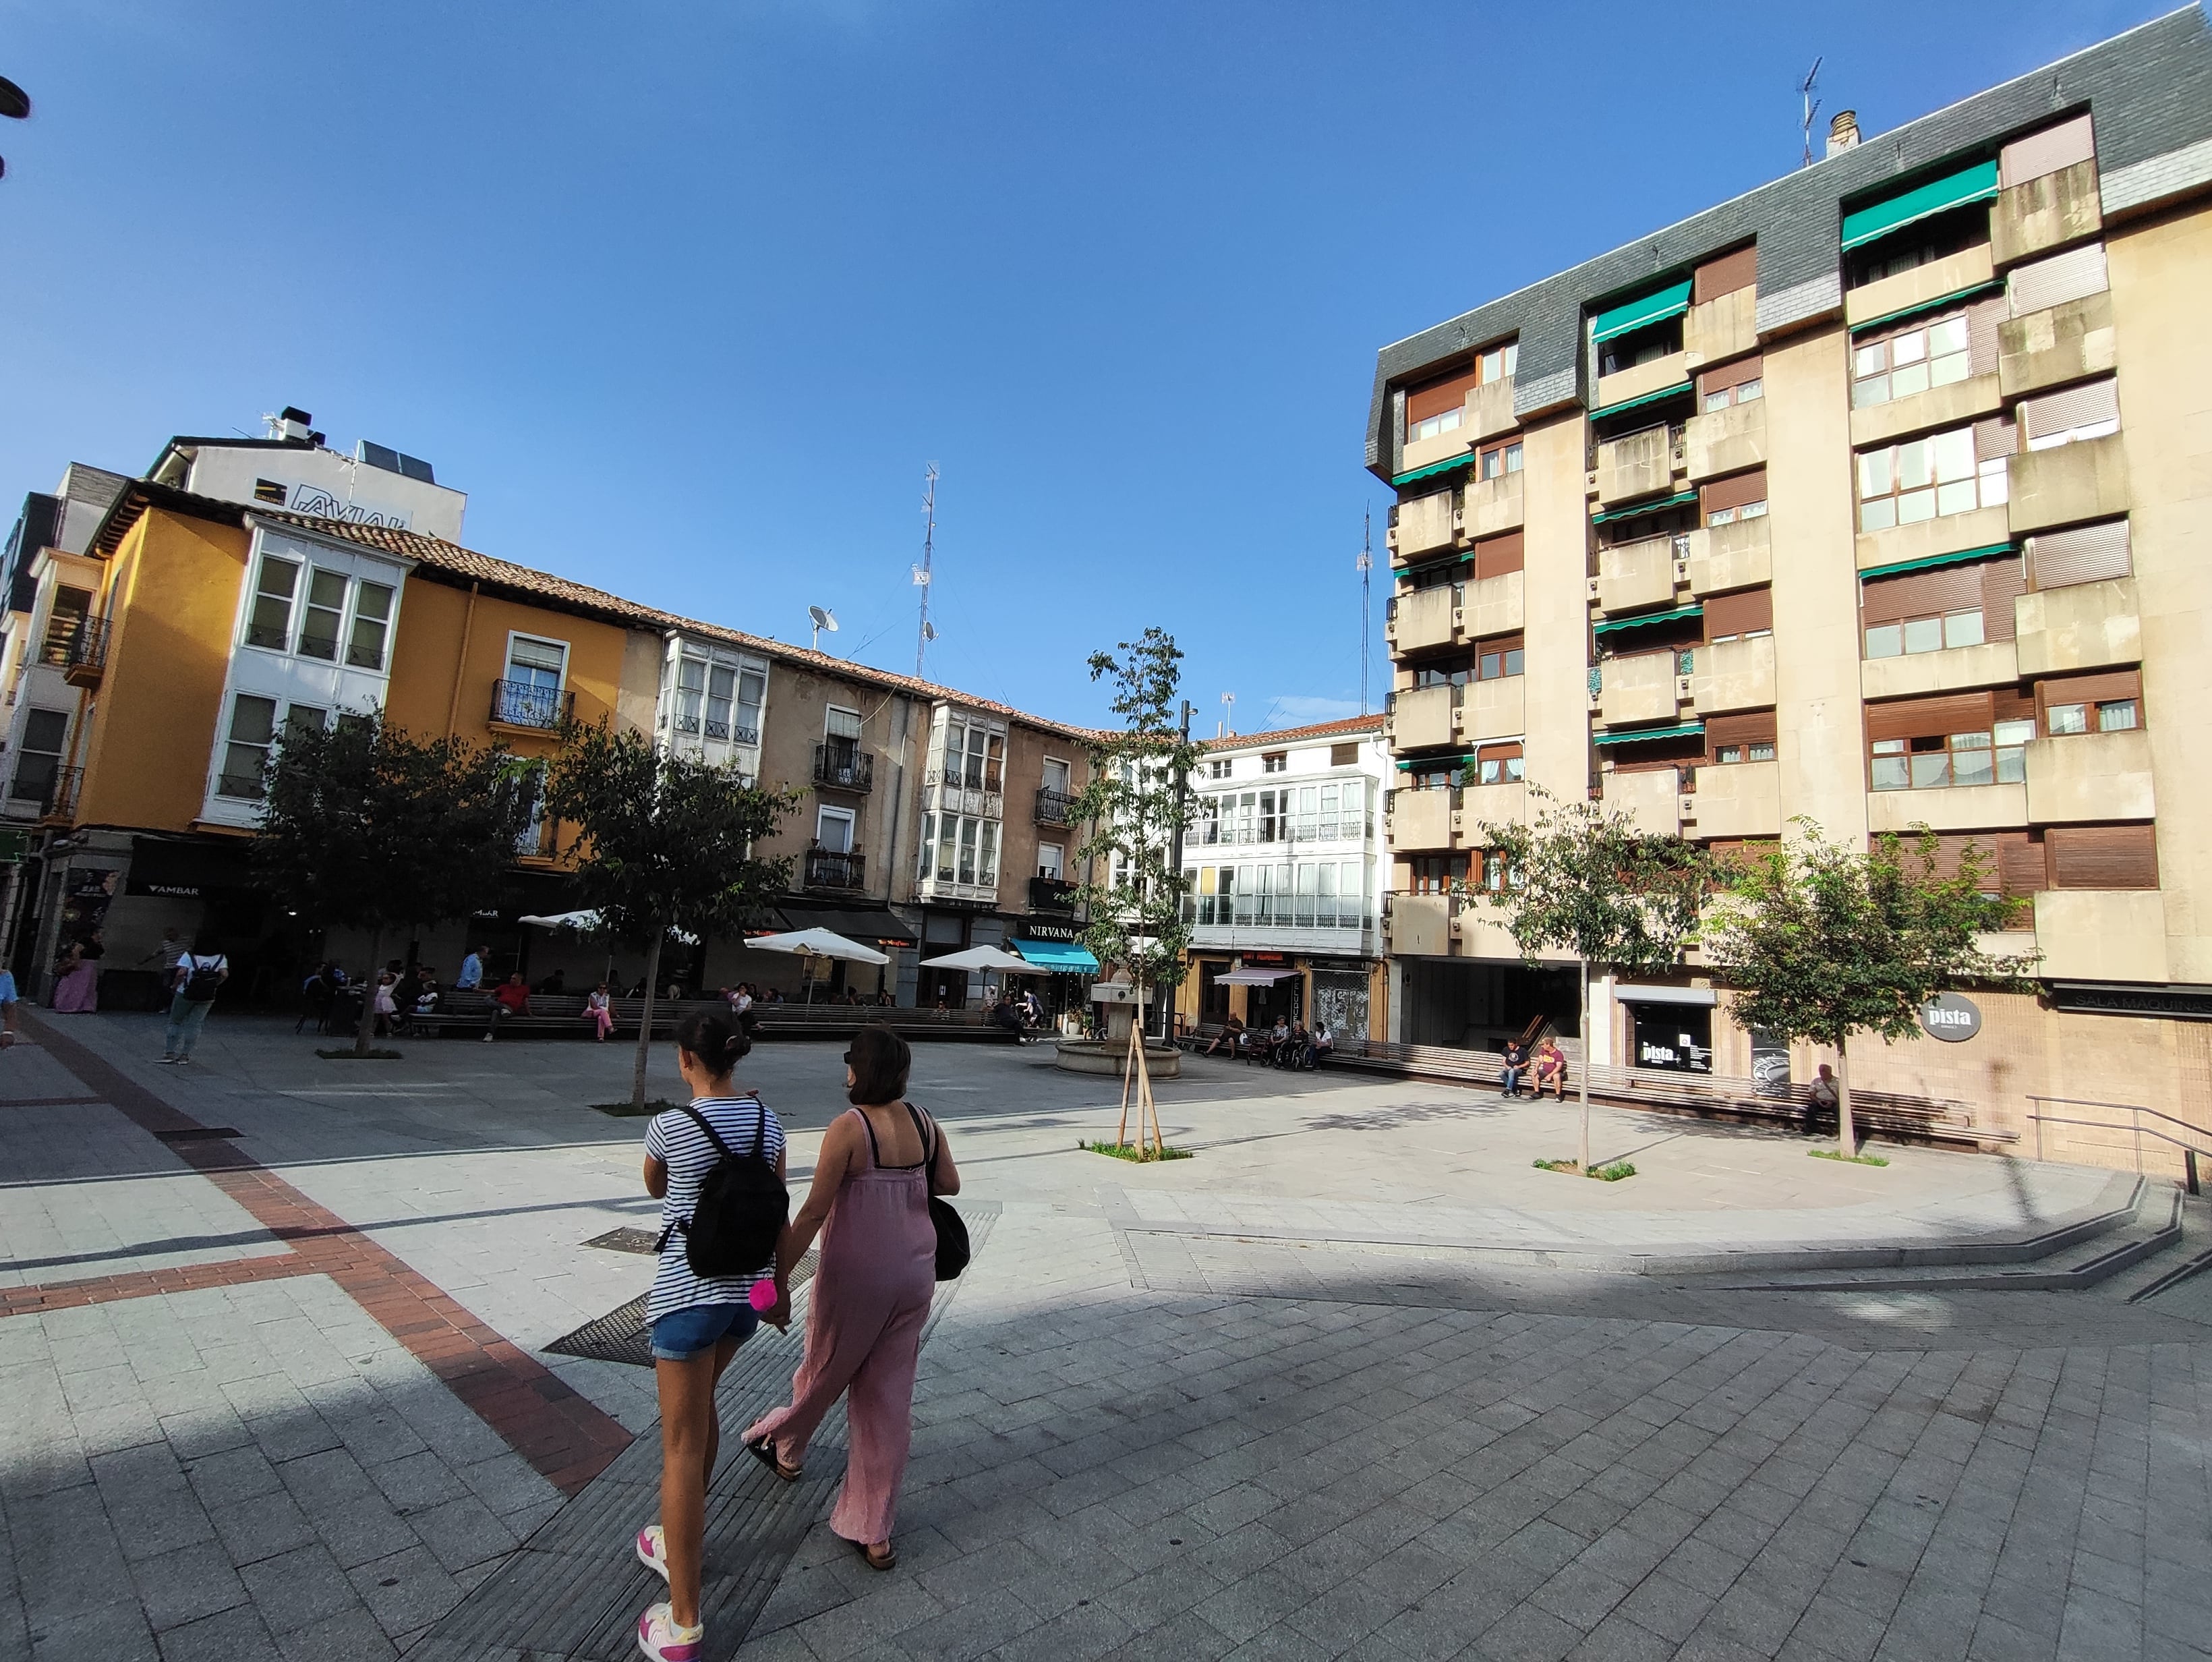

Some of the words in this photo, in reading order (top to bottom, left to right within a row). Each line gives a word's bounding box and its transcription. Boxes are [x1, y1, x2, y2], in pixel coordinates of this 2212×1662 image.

[256, 493, 284, 505] GRUPO
[157, 886, 199, 896] AMBAR
[1029, 925, 1074, 938] NIRVANA
[2075, 995, 2119, 1008] SALA
[1929, 1008, 1972, 1026] pista
[1643, 1045, 1674, 1061] pista
